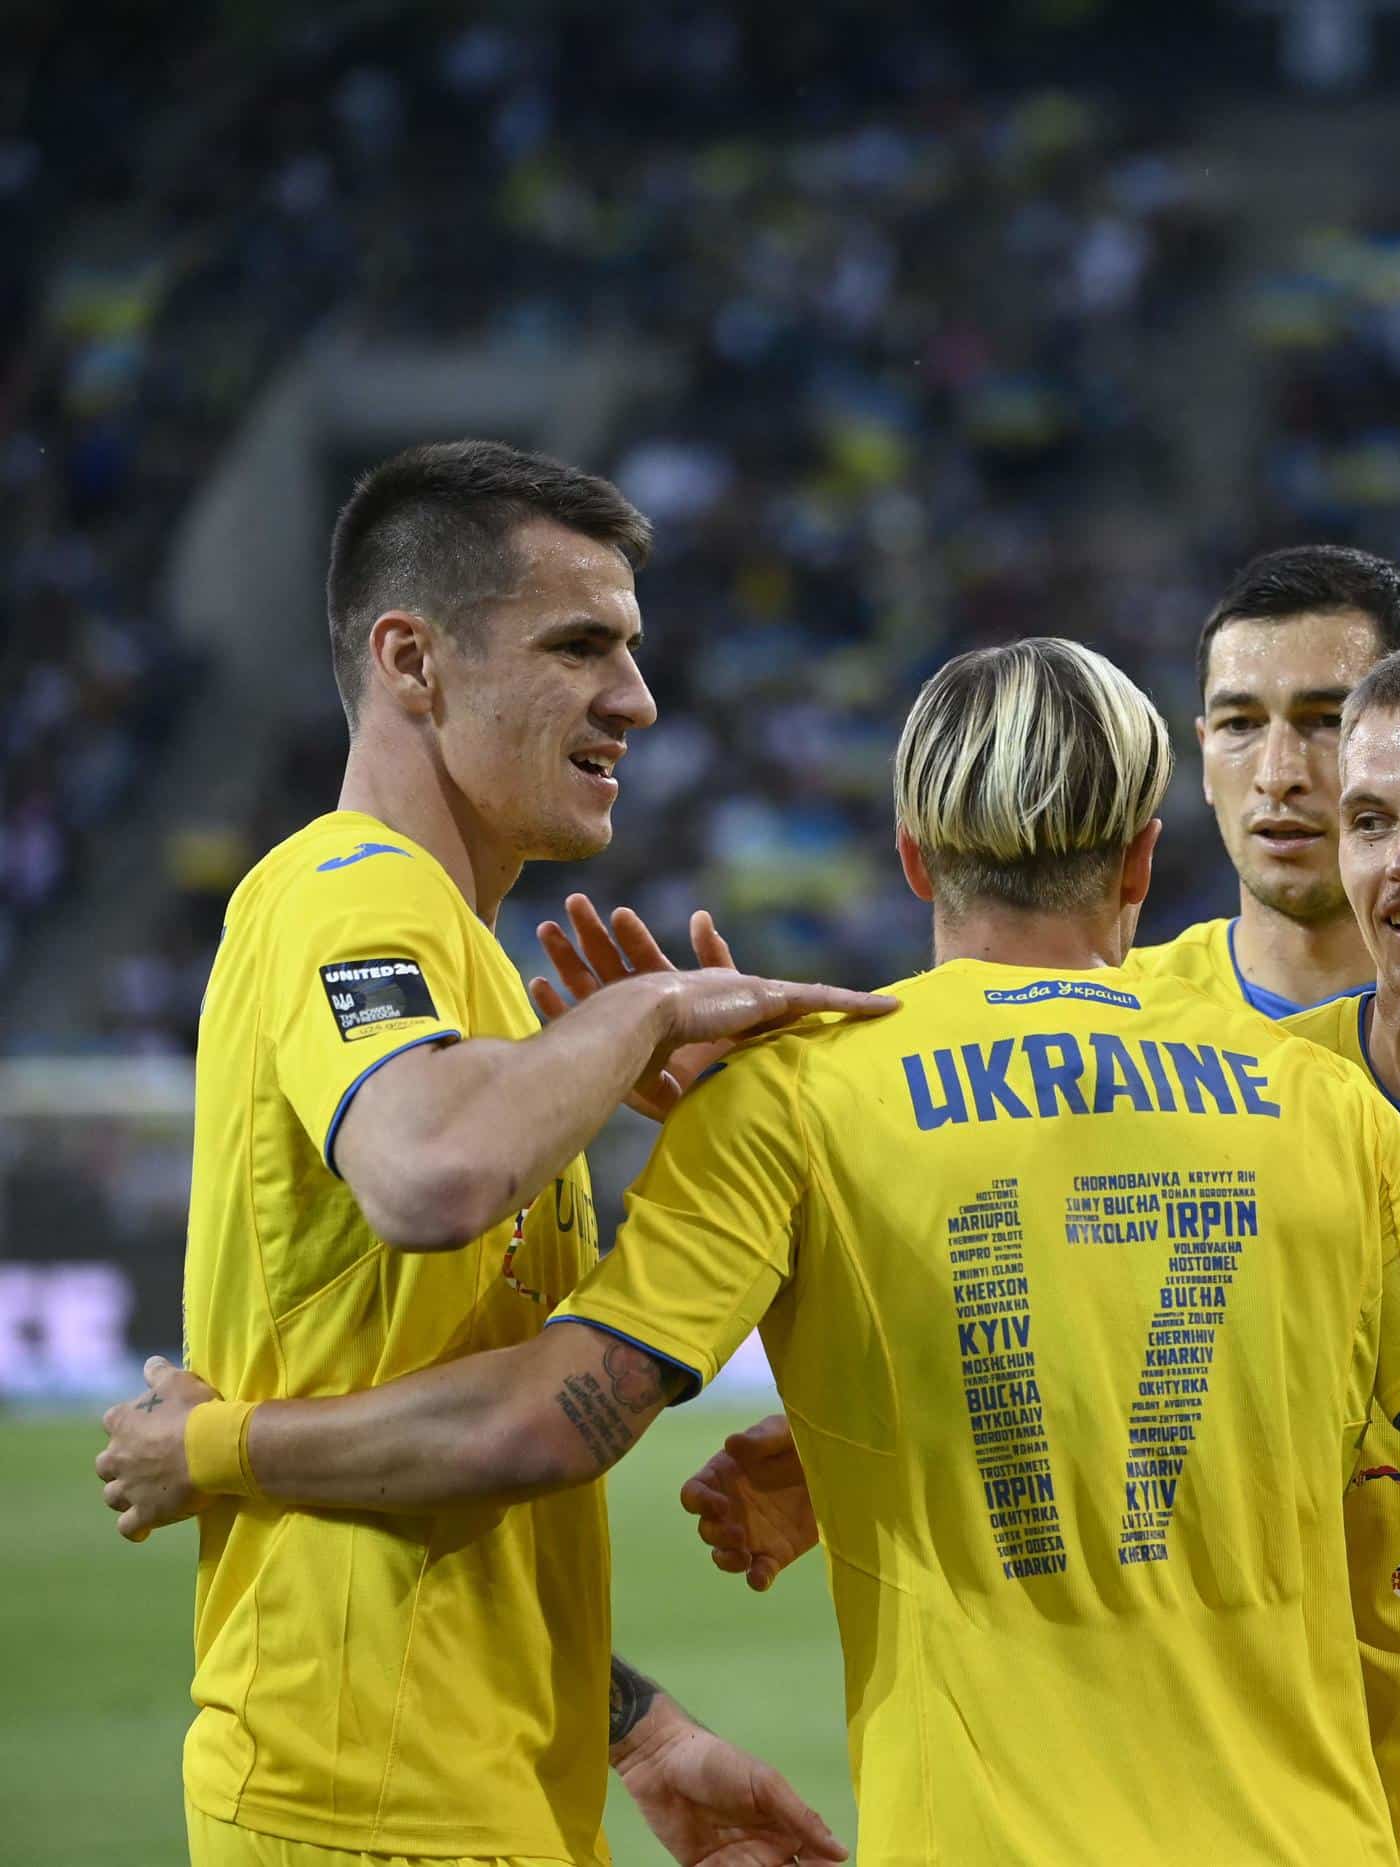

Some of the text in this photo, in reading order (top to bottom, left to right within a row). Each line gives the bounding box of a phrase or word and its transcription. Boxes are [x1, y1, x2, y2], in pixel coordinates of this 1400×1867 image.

[987, 982, 1132, 1004] Слава Україні!
[901, 1032, 1281, 1131] UKRAINE
[1073, 1172, 1180, 1191] CHORNOBAIVKA
[1188, 1171, 1255, 1183] KRYVYY RIH
[1161, 1188, 1196, 1199] ROHAN
[1066, 1194, 1160, 1215] SUMY BUCHA
[948, 1210, 1021, 1233] MARIUPOL
[1166, 1200, 1258, 1241] IRPIN
[992, 1231, 1024, 1243] ZOLOTE
[1065, 1220, 1158, 1244] MYKOLAIV
[950, 1247, 990, 1264] DNIPRO
[1173, 1241, 1243, 1254] VOLNOVAKHA
[991, 1263, 1024, 1275] ISLAND
[1169, 1255, 1238, 1272] HOSTOMEL
[953, 1277, 1028, 1303] KHERSON
[1160, 1286, 1226, 1309] BUCHA
[956, 1298, 1030, 1319] VOLNOVAKHA
[1188, 1312, 1224, 1325] ZOLOTE
[958, 1314, 1031, 1356] KYIV
[1148, 1329, 1215, 1346] CHERNIHIV
[962, 1352, 1035, 1376] MOSHCHUN
[1145, 1346, 1213, 1367] KHARKIV
[966, 1380, 1041, 1413] BUCHA
[1139, 1378, 1208, 1396] OKHTYRKA
[971, 1407, 1042, 1432] MYKOLAIV
[1129, 1425, 1196, 1444] MARIUPOL
[1012, 1441, 1048, 1456] ROHAN
[1126, 1459, 1183, 1478] MAKARIV
[984, 1472, 1055, 1510] IRPIN
[1126, 1479, 1177, 1512] KYIV
[991, 1505, 1059, 1529] OKHTYRKA
[1121, 1511, 1154, 1529] LUTSK
[1026, 1536, 1065, 1554] ODESA
[1118, 1543, 1168, 1565] KHERSON
[1003, 1554, 1066, 1580] KHARKIV
